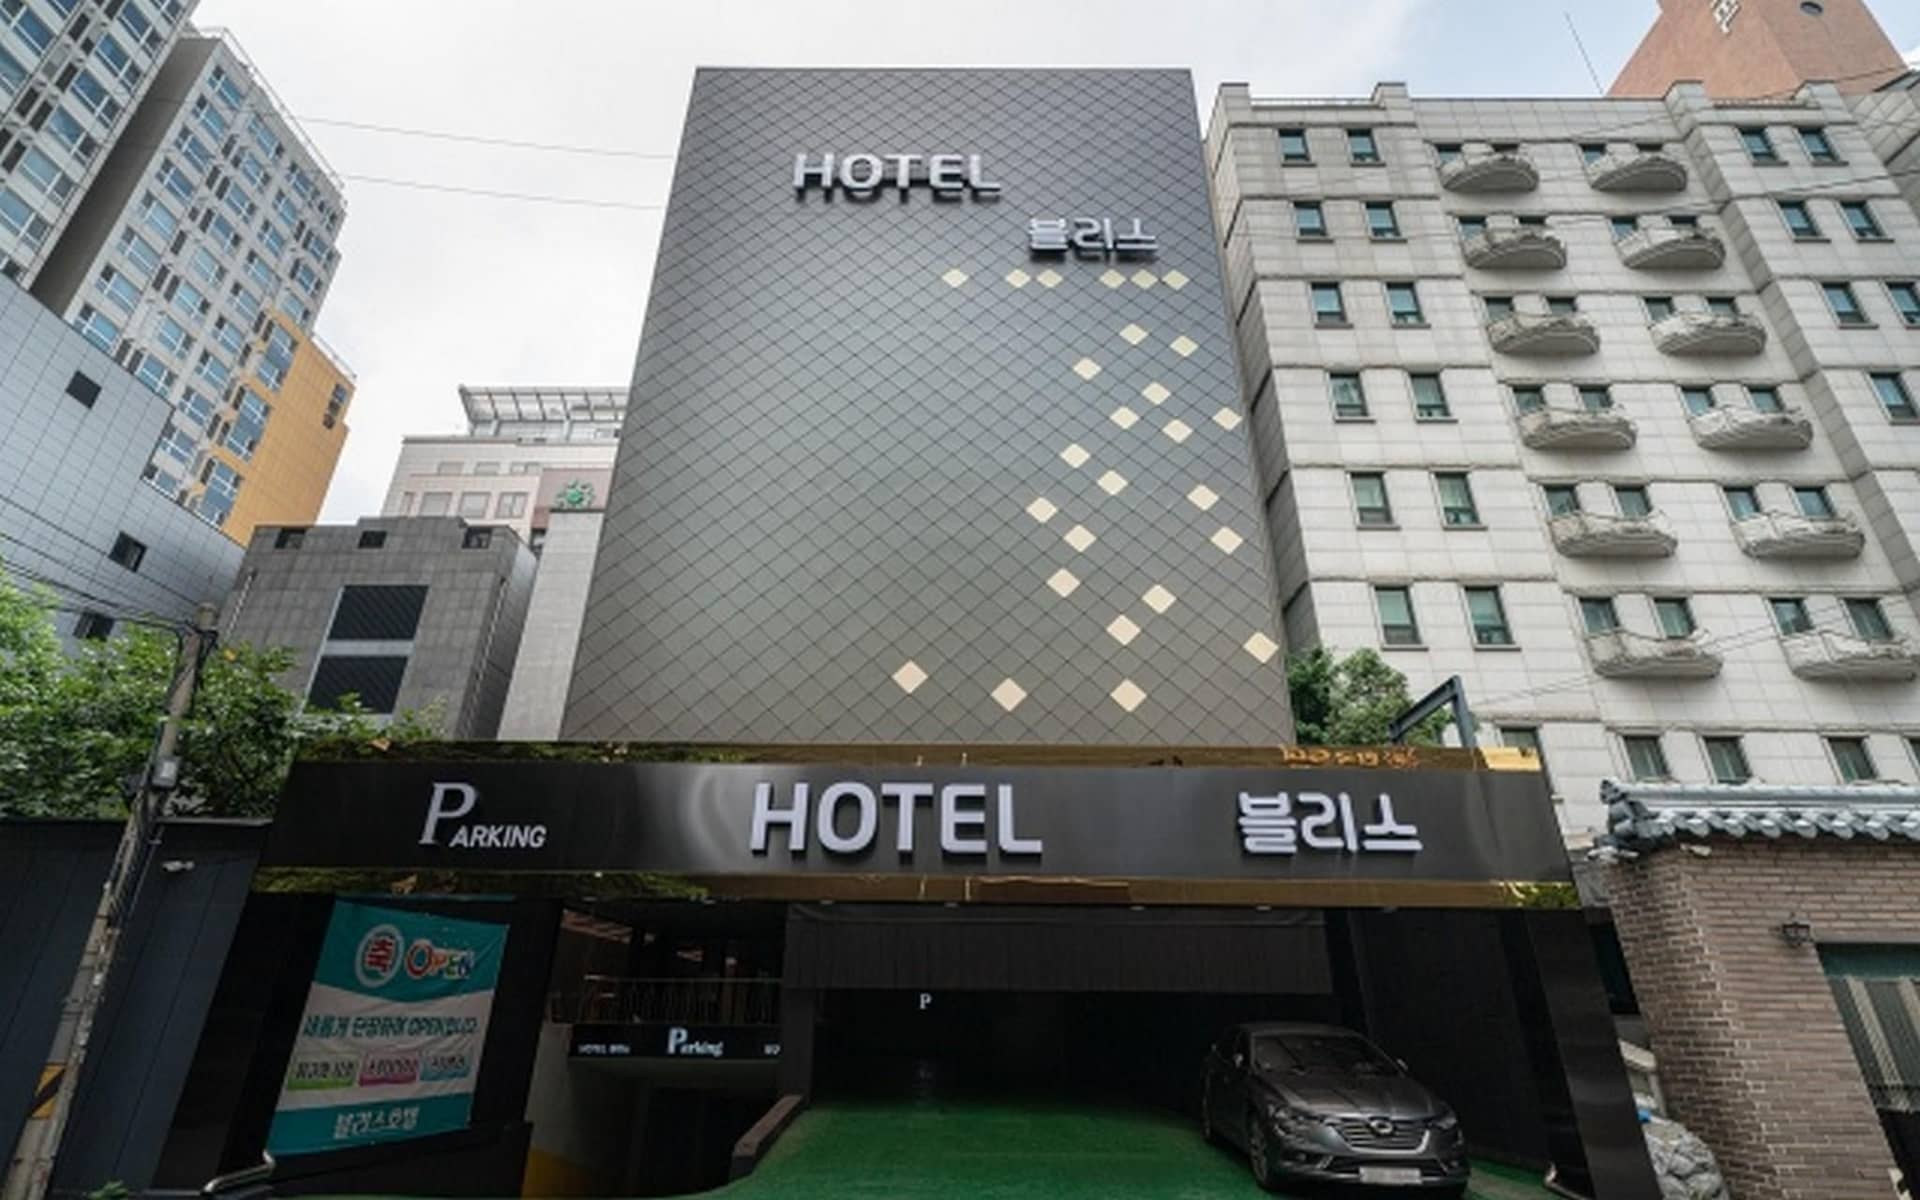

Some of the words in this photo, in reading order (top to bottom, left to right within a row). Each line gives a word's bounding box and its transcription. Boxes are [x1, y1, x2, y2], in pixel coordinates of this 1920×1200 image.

[793, 152, 1000, 197] HOTEL
[1029, 217, 1157, 251] 블리스
[418, 782, 546, 849] PARKING
[749, 781, 1042, 854] HOTEL
[1238, 791, 1423, 853] 블리스
[366, 936, 395, 973] 축
[405, 940, 475, 980] OPEN
[919, 993, 932, 1009] P
